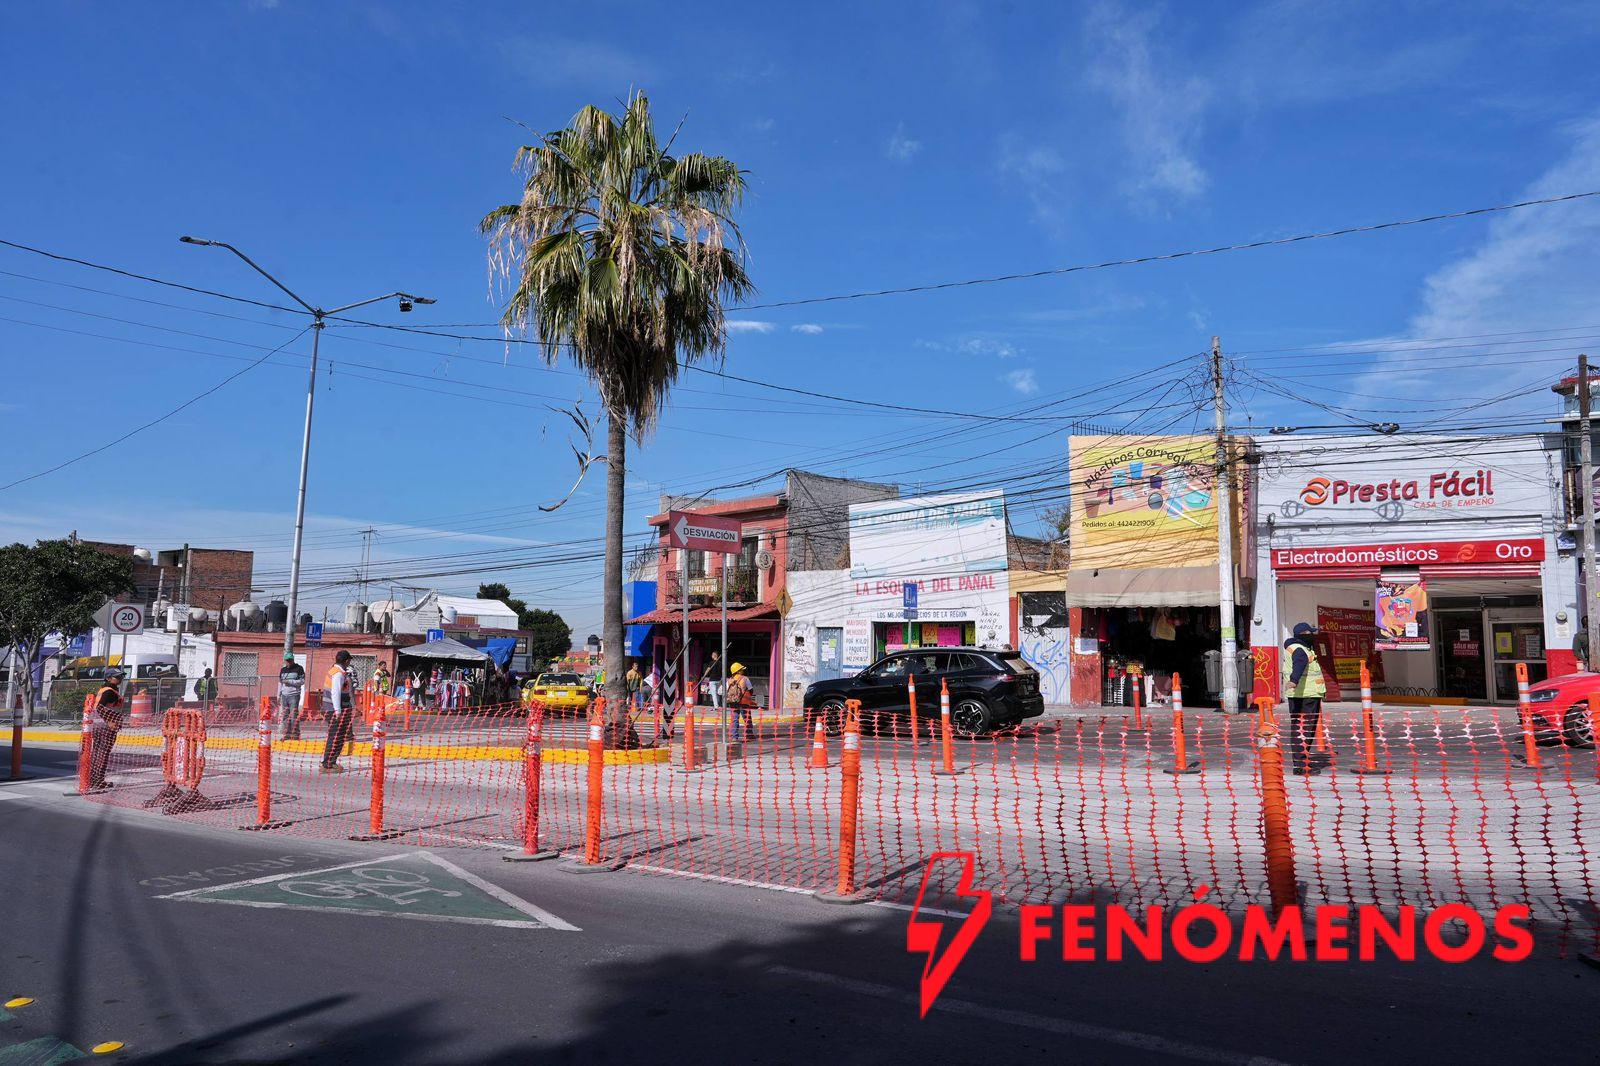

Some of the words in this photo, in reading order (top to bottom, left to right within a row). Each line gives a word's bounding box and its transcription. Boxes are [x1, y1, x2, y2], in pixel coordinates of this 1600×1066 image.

[1332, 477, 1419, 504] Presta
[1429, 469, 1495, 499] Fácil
[1413, 500, 1437, 509] CASA
[1441, 499, 1453, 507] DE
[1457, 496, 1495, 507] EMPEÑO
[683, 527, 736, 541] DESVIACIÓN
[1277, 546, 1439, 565] Electrodomésticos
[1495, 543, 1533, 559] Oro
[855, 582, 869, 596] LA
[932, 577, 953, 593] DEL
[958, 572, 996, 591] PAÑAL
[121, 612, 134, 621] 20
[876, 611, 886, 619] LOS
